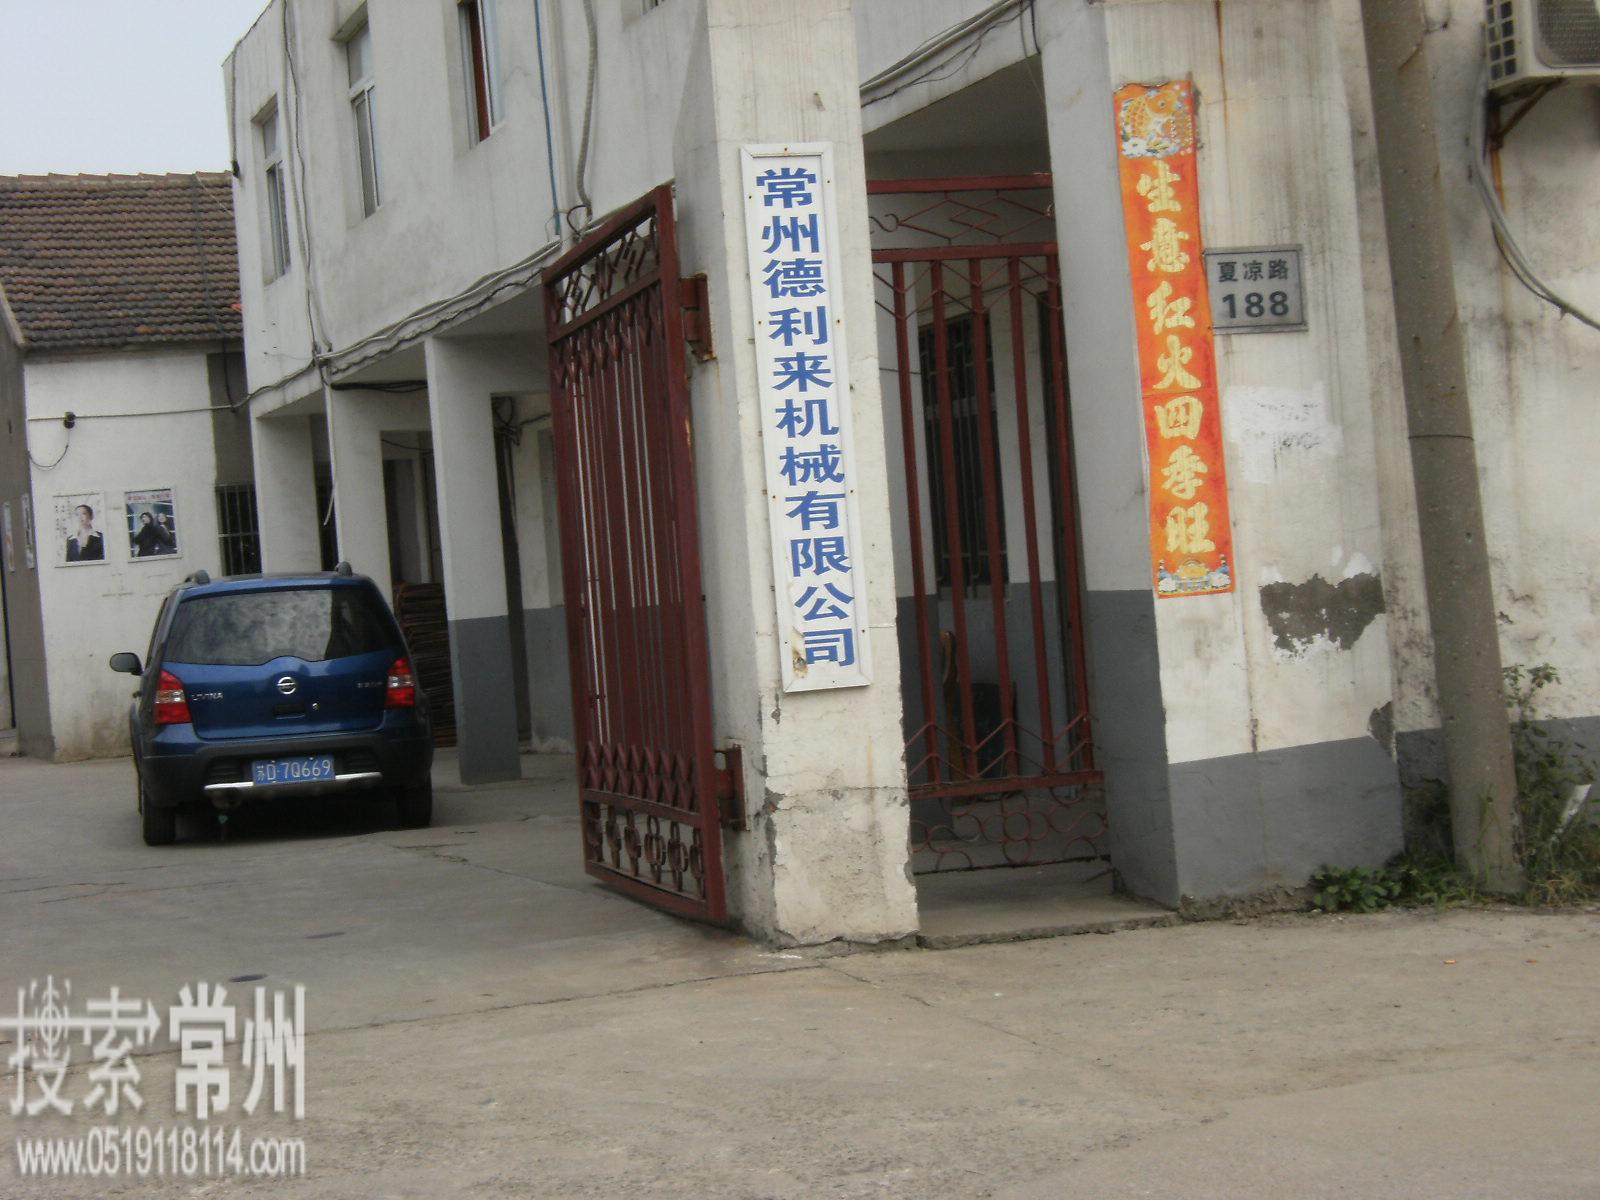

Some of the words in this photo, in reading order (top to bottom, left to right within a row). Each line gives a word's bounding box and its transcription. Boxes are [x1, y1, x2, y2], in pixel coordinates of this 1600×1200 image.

[1136, 159, 1216, 554] 生意红火四季旺
[1217, 258, 1289, 282] 夏凉路
[1222, 291, 1289, 319] 188
[756, 167, 855, 669] 常州德利来机械有限公司
